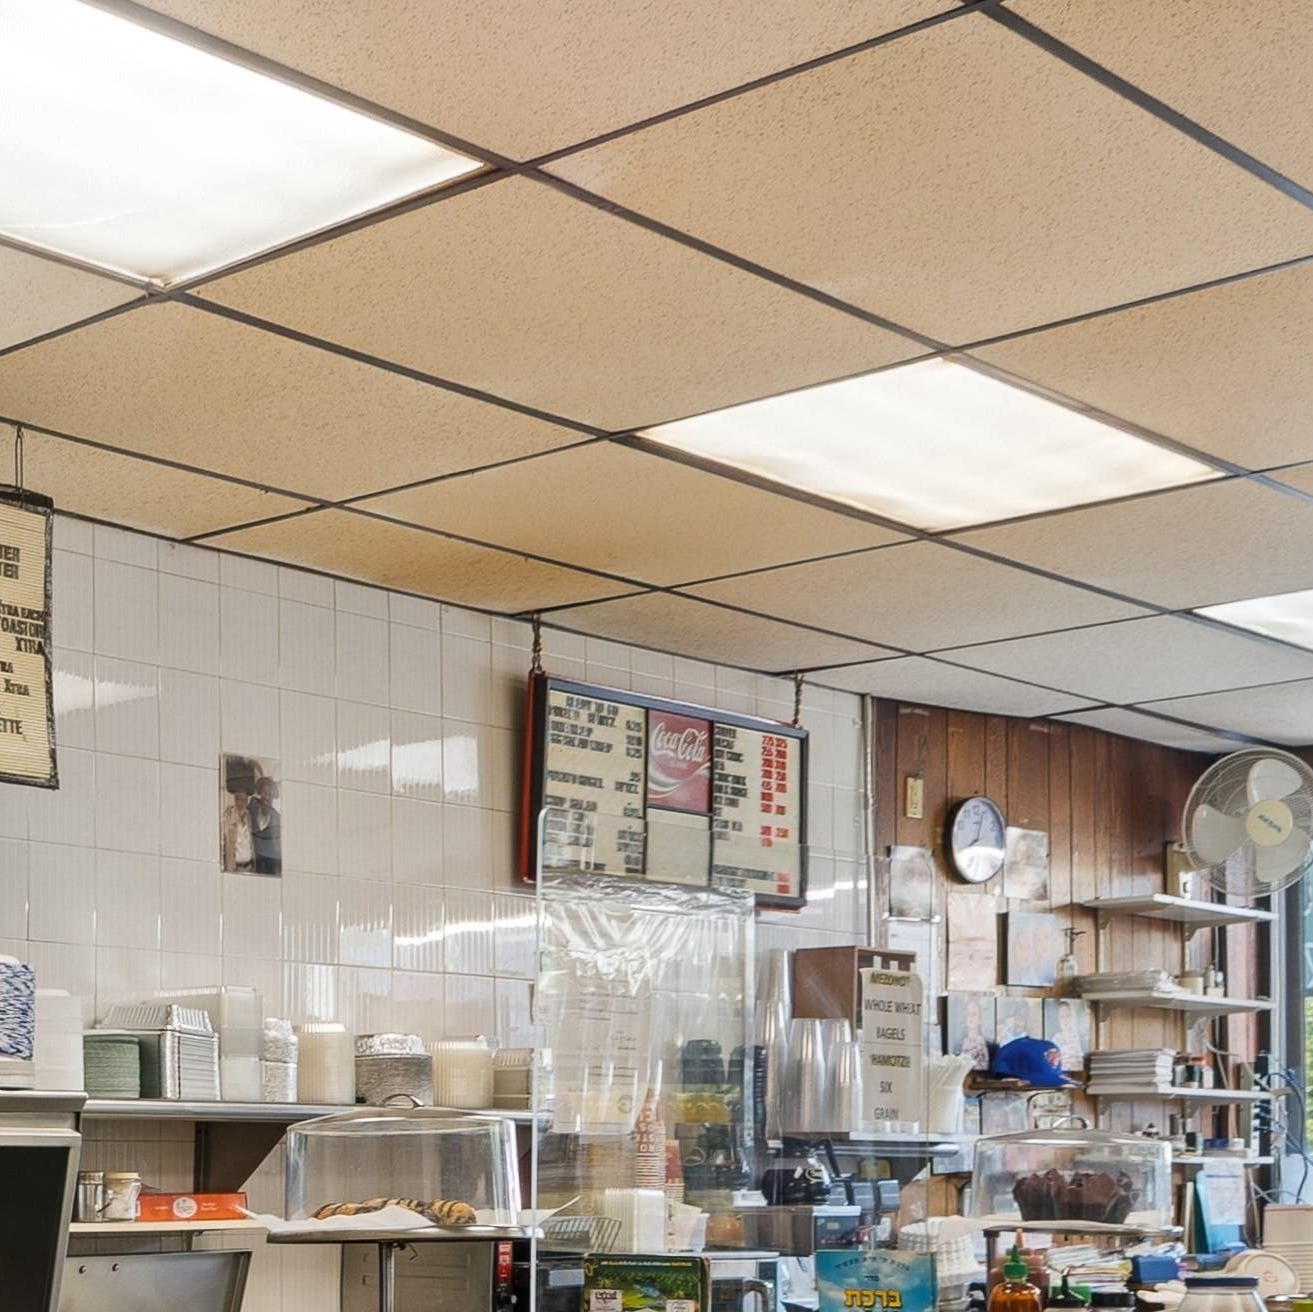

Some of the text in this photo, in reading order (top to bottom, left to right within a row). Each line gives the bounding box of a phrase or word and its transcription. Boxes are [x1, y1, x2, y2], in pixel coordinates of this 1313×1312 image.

[15, 637, 44, 655] XTRA
[864, 999, 921, 1015] WHOLE WHEAT
[876, 1026, 905, 1041] BAGELS
[880, 1081, 893, 1093] SIX
